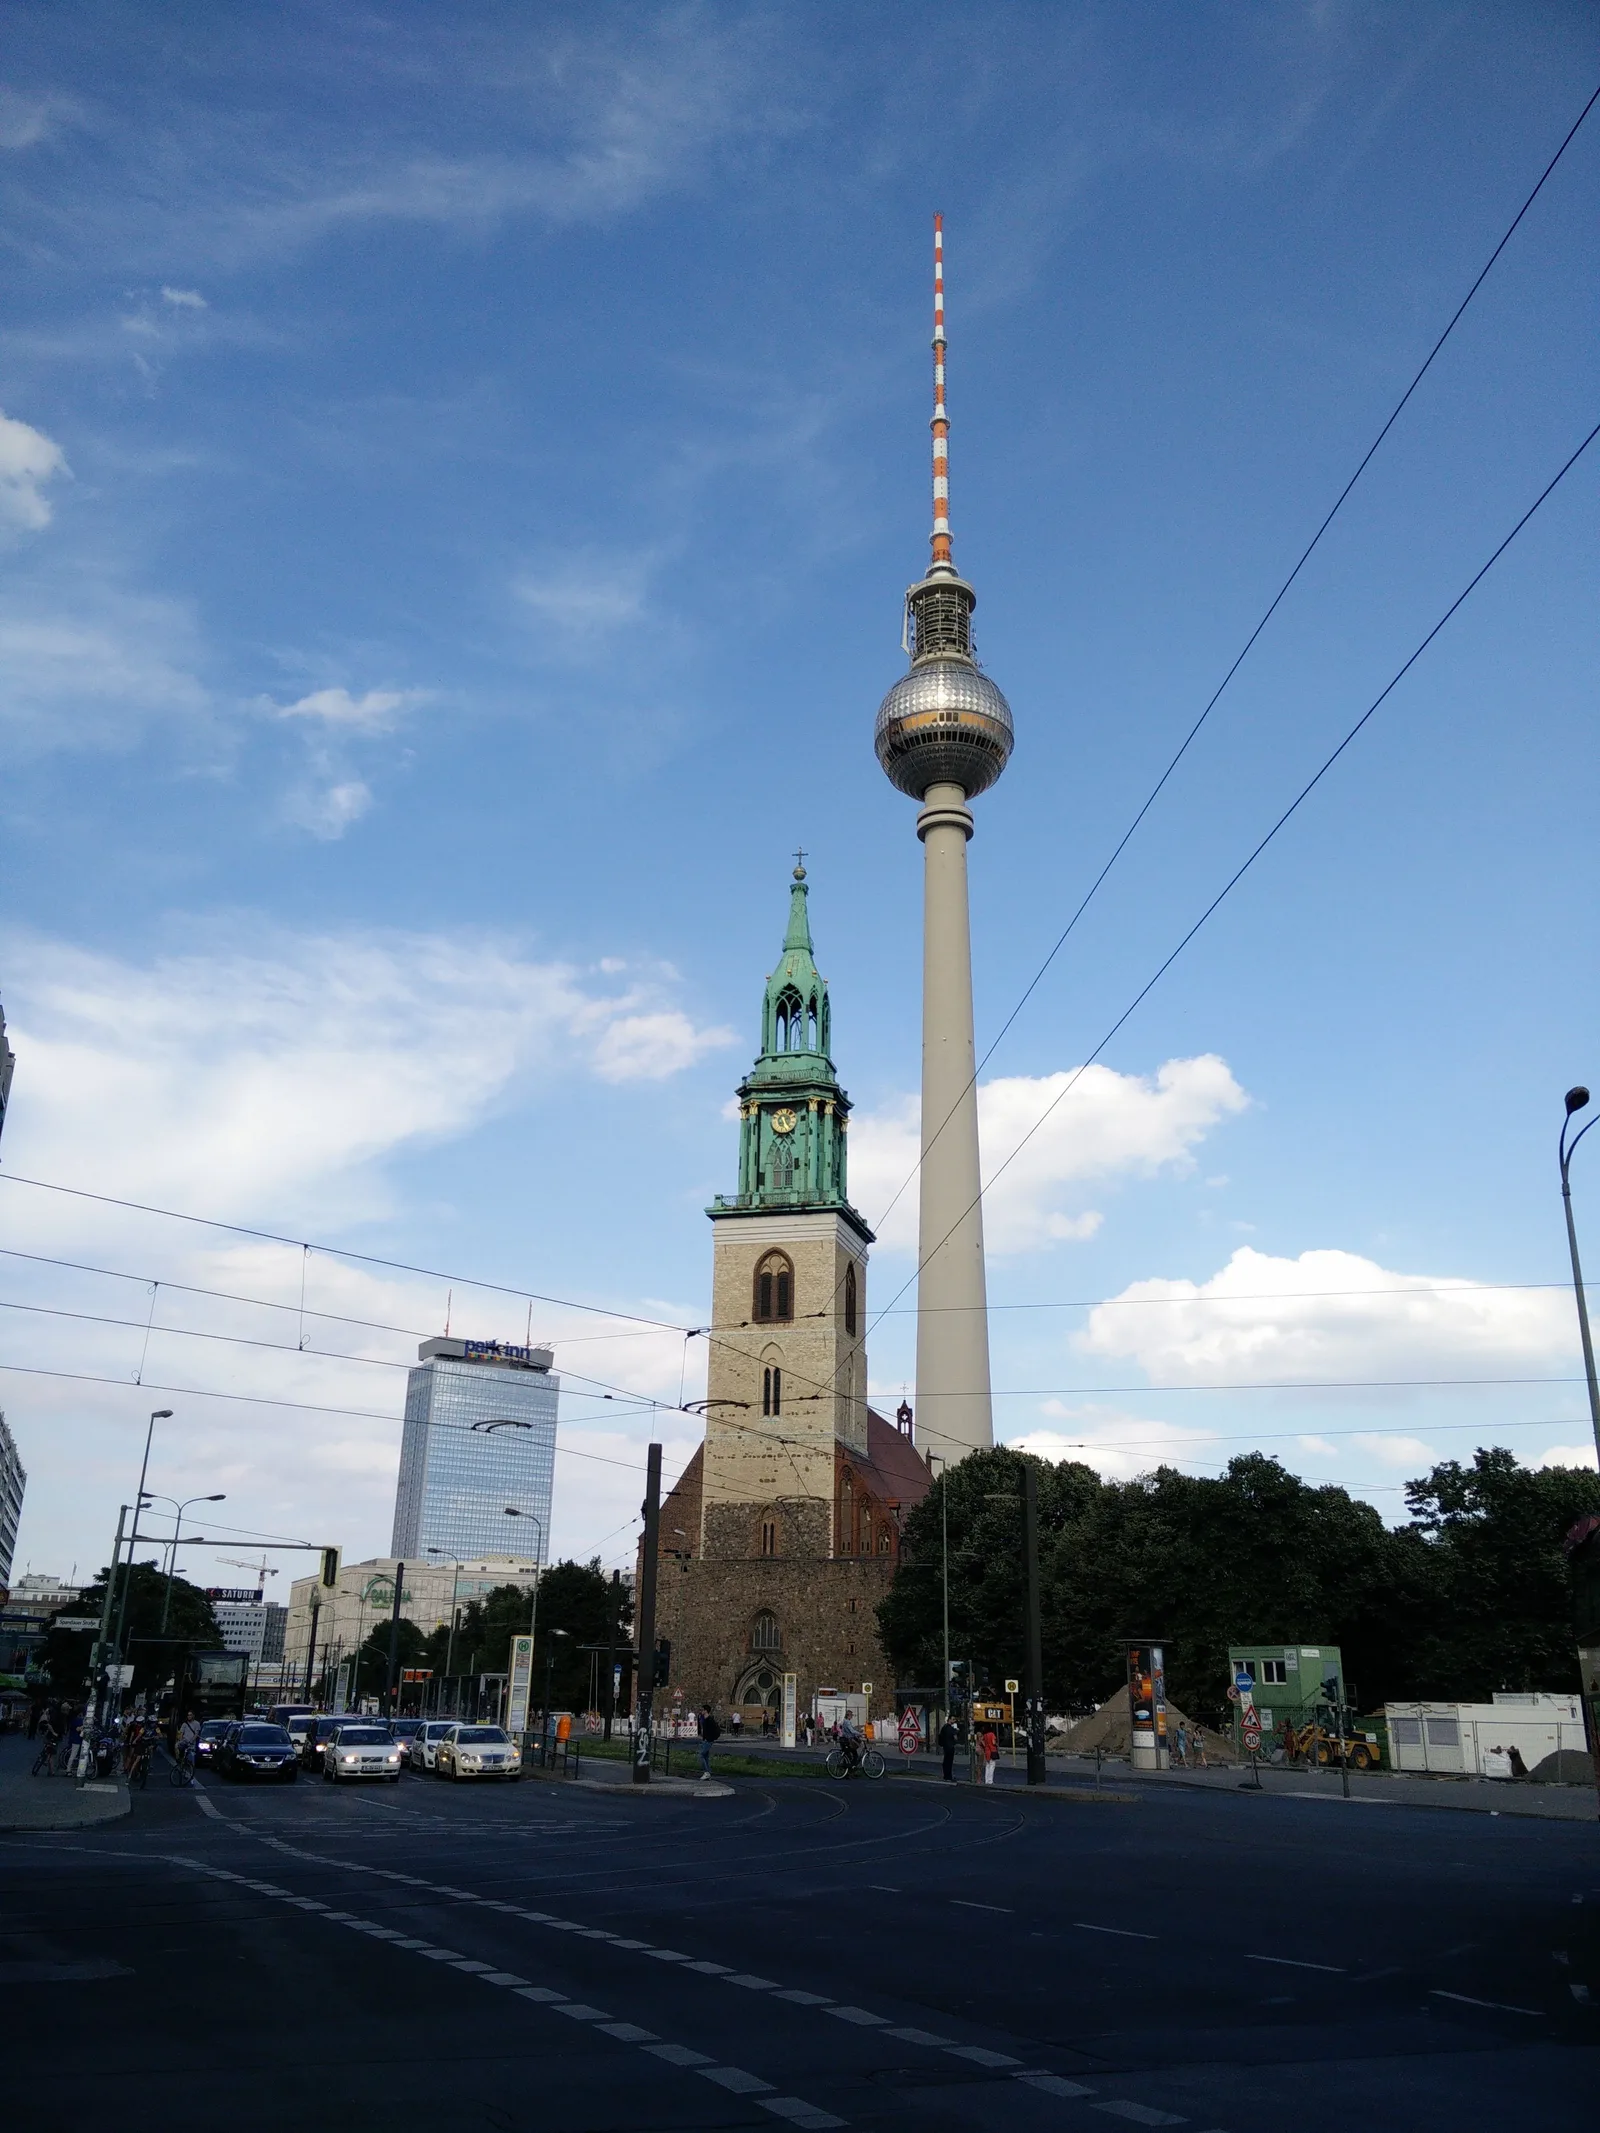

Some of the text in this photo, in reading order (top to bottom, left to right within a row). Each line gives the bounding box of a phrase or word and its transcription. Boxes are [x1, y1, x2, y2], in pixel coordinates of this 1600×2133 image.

[506, 1341, 530, 1360] inn
[221, 1590, 255, 1599] SATURN
[371, 1589, 412, 1603] GALEIA
[987, 1708, 1001, 1719] CAT
[903, 1739, 914, 1749] 30
[1246, 1735, 1257, 1745] 30
